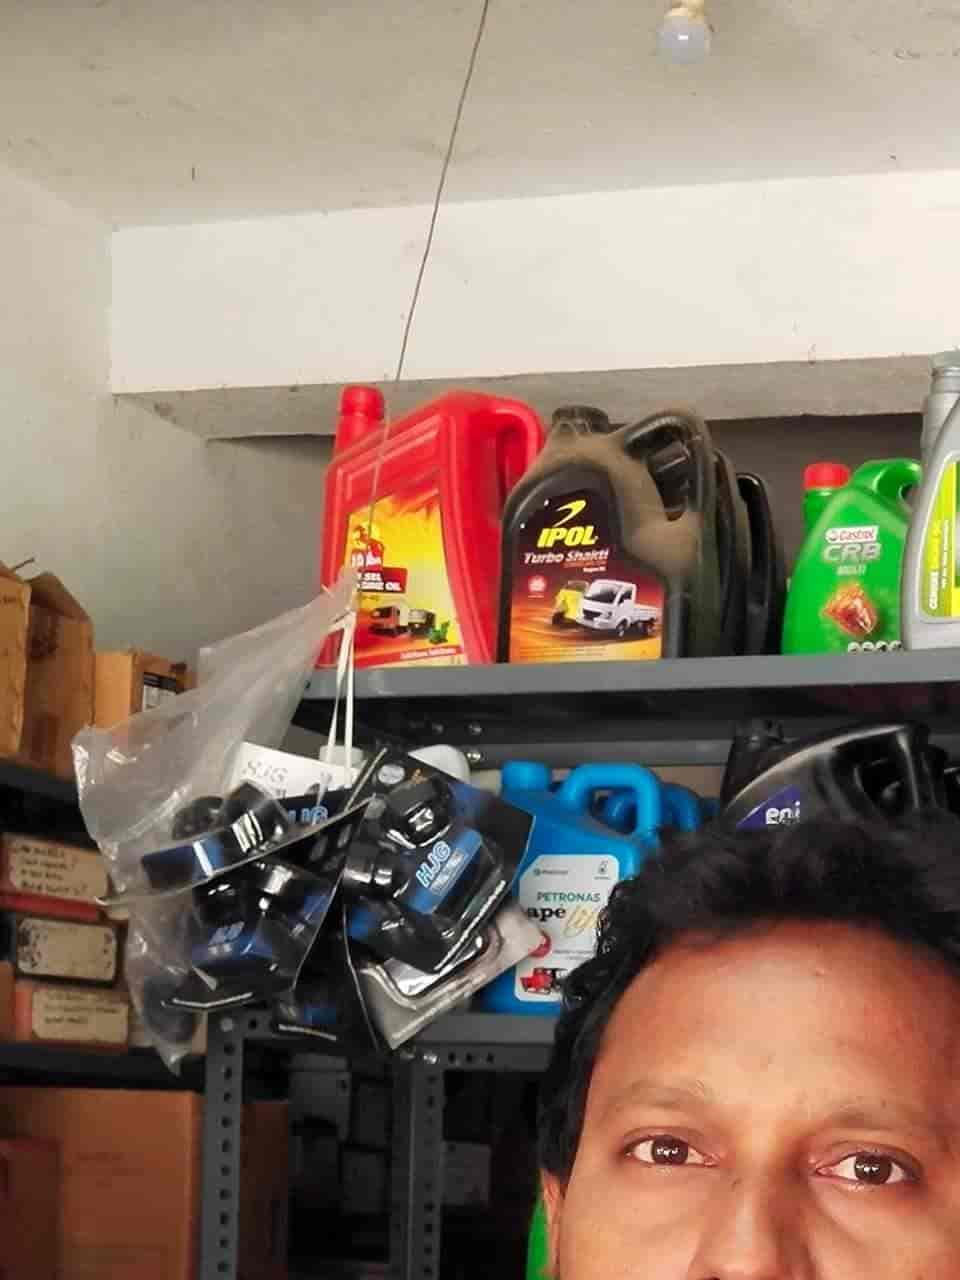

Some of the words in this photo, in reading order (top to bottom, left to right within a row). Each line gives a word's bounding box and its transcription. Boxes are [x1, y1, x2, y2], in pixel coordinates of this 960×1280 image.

[537, 525, 597, 548] IPOL
[524, 551, 564, 564] Turbo
[565, 548, 609, 562] Shakti
[823, 543, 881, 561] CRB
[415, 841, 451, 888] HJG
[537, 891, 601, 903] PETRONAS
